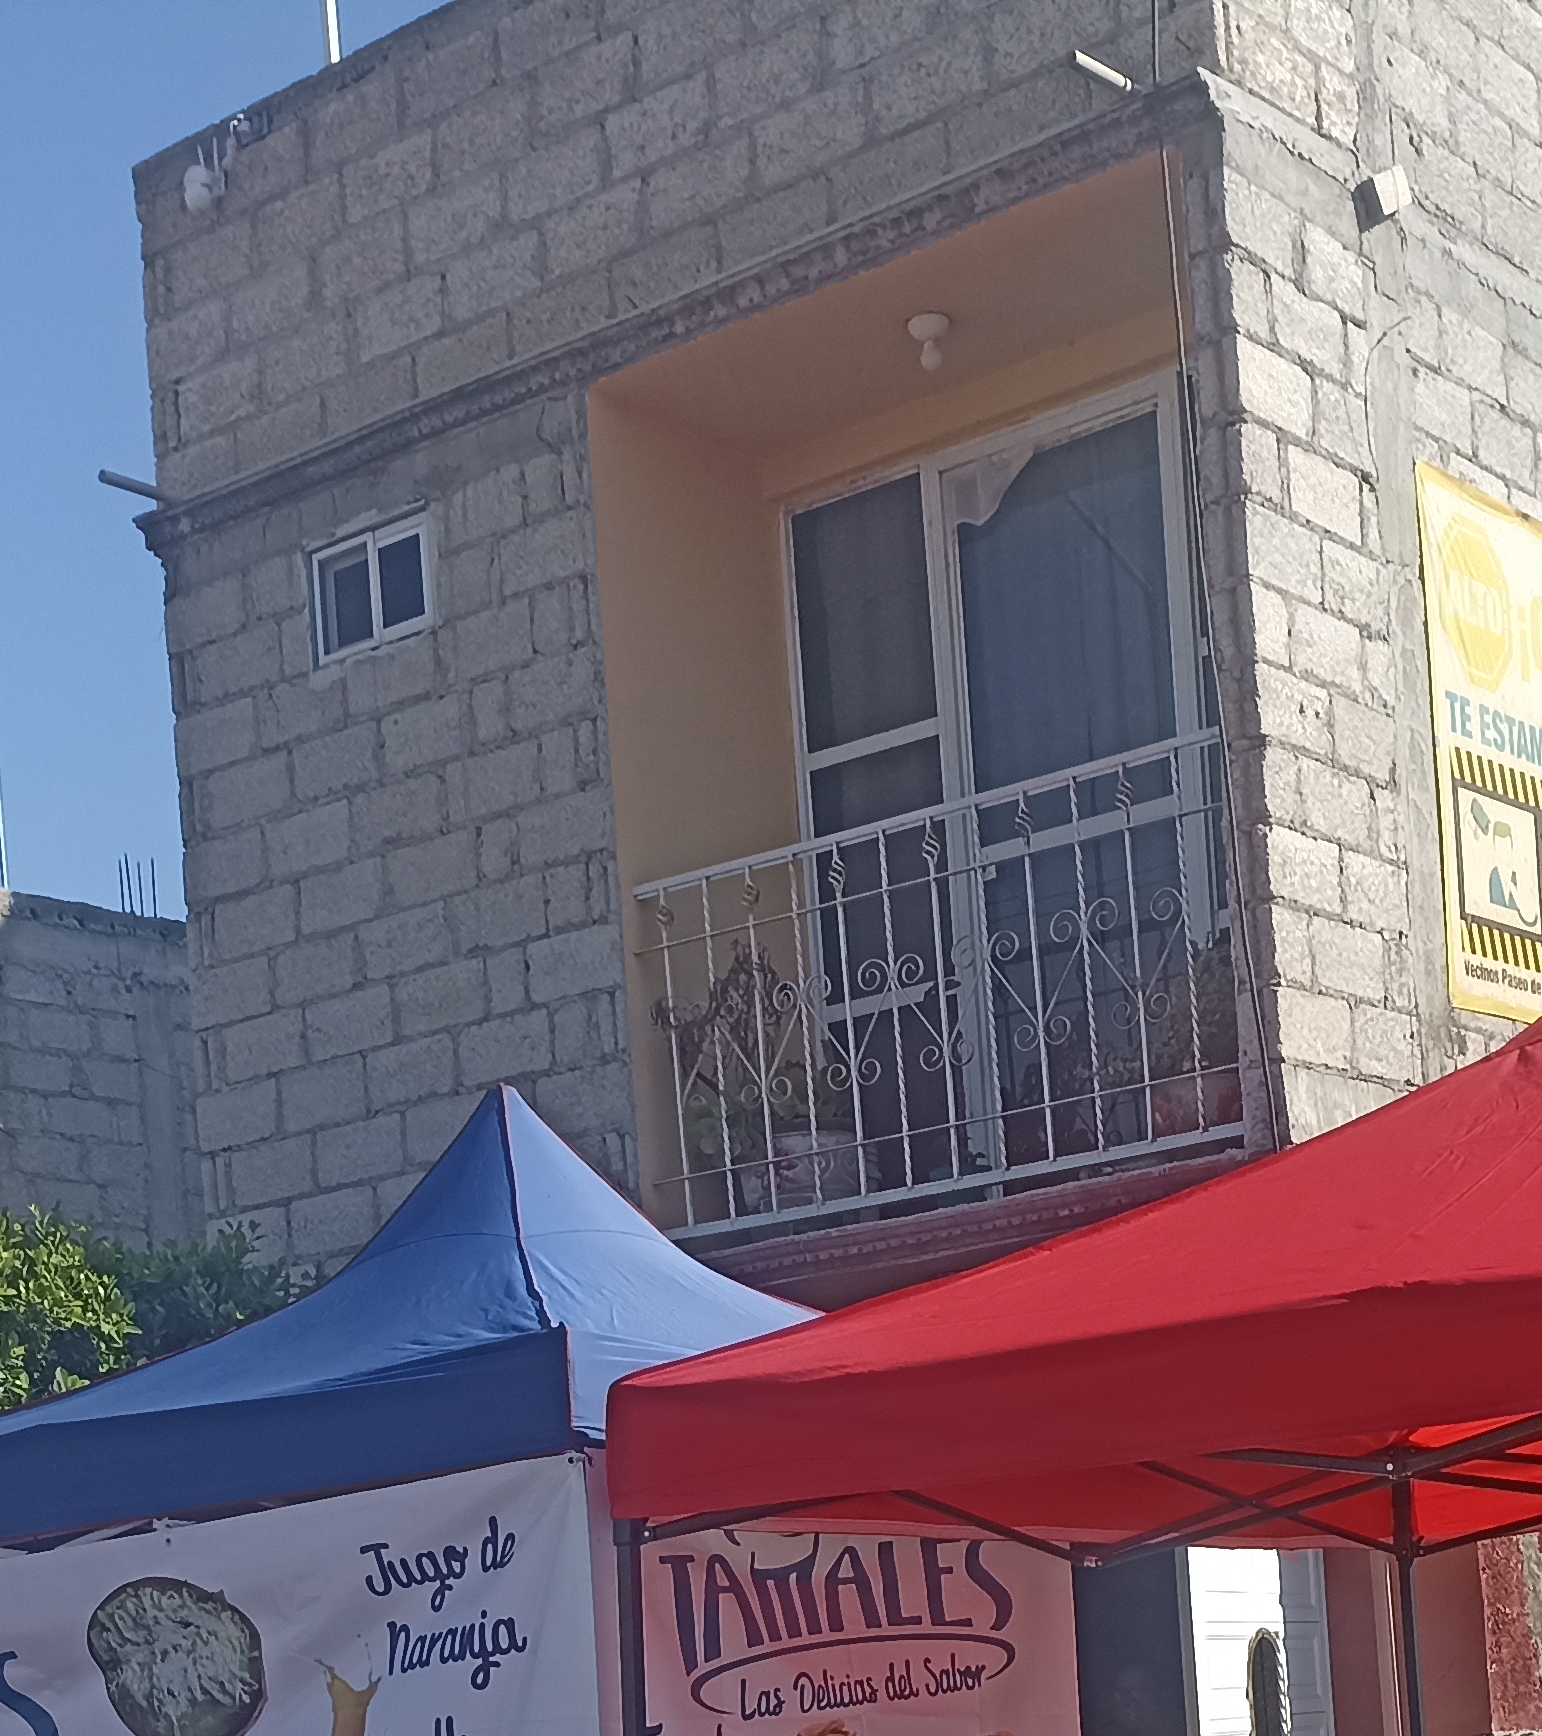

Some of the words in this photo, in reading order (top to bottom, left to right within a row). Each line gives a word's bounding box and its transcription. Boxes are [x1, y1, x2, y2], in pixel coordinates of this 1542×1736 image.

[1445, 690, 1472, 739] TE
[1464, 959, 1499, 984] Vecinos
[1502, 968, 1528, 991] Paseo
[1531, 979, 1541, 995] de
[359, 1542, 468, 1611] Jugo
[481, 1516, 516, 1572] de
[659, 1532, 1013, 1676] TAMALES
[387, 1610, 528, 1690] Naranja
[740, 1679, 785, 1721] Las
[793, 1670, 878, 1713] Delicias
[886, 1660, 919, 1699] del
[925, 1653, 986, 1697] Sabor
